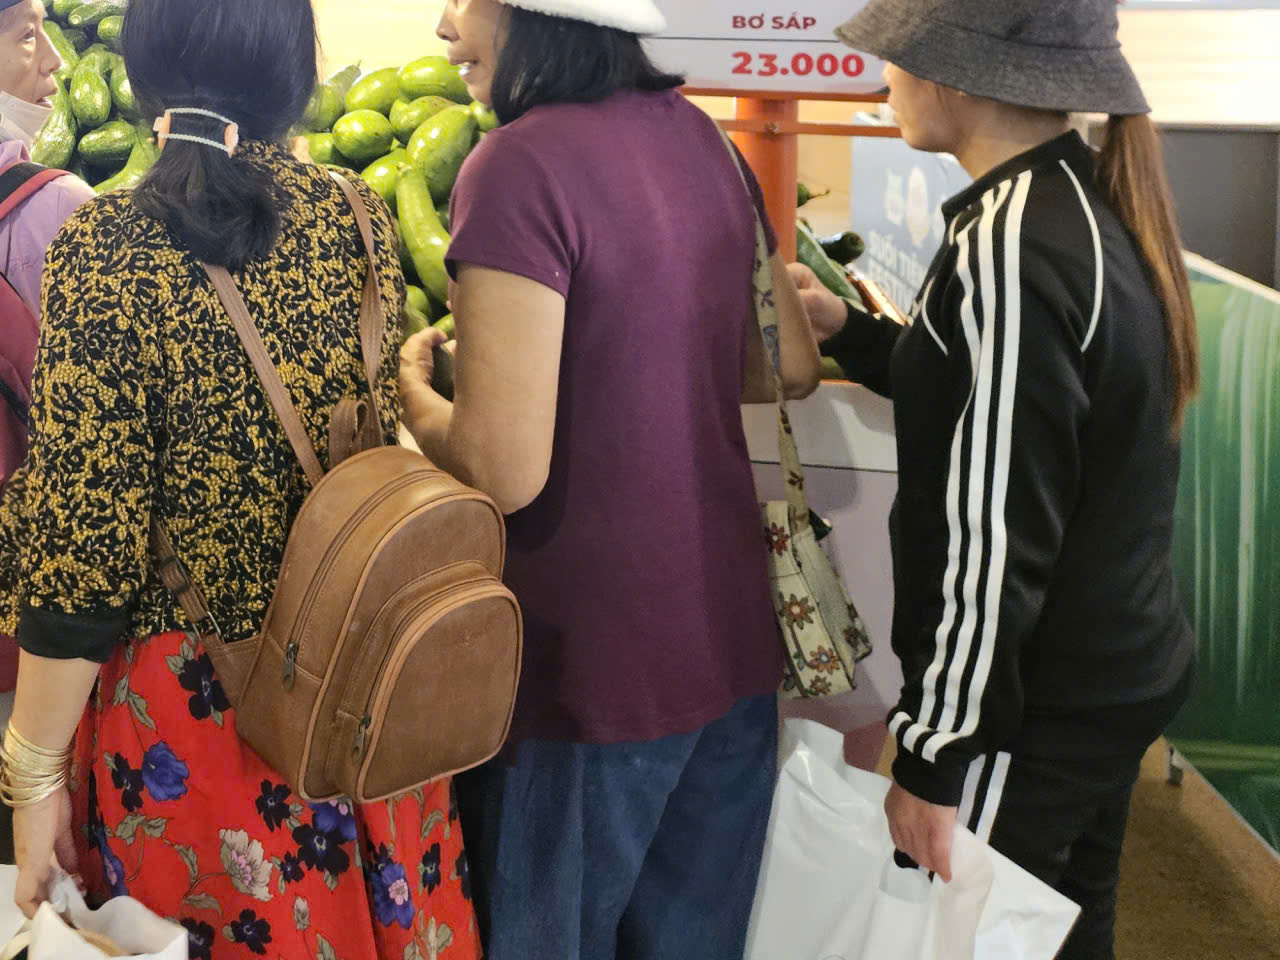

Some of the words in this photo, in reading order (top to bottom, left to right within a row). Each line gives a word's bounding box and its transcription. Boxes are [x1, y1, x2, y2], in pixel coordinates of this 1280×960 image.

[731, 14, 765, 29] BƠ
[771, 12, 816, 30] SÁP
[731, 52, 864, 77] 23.000
